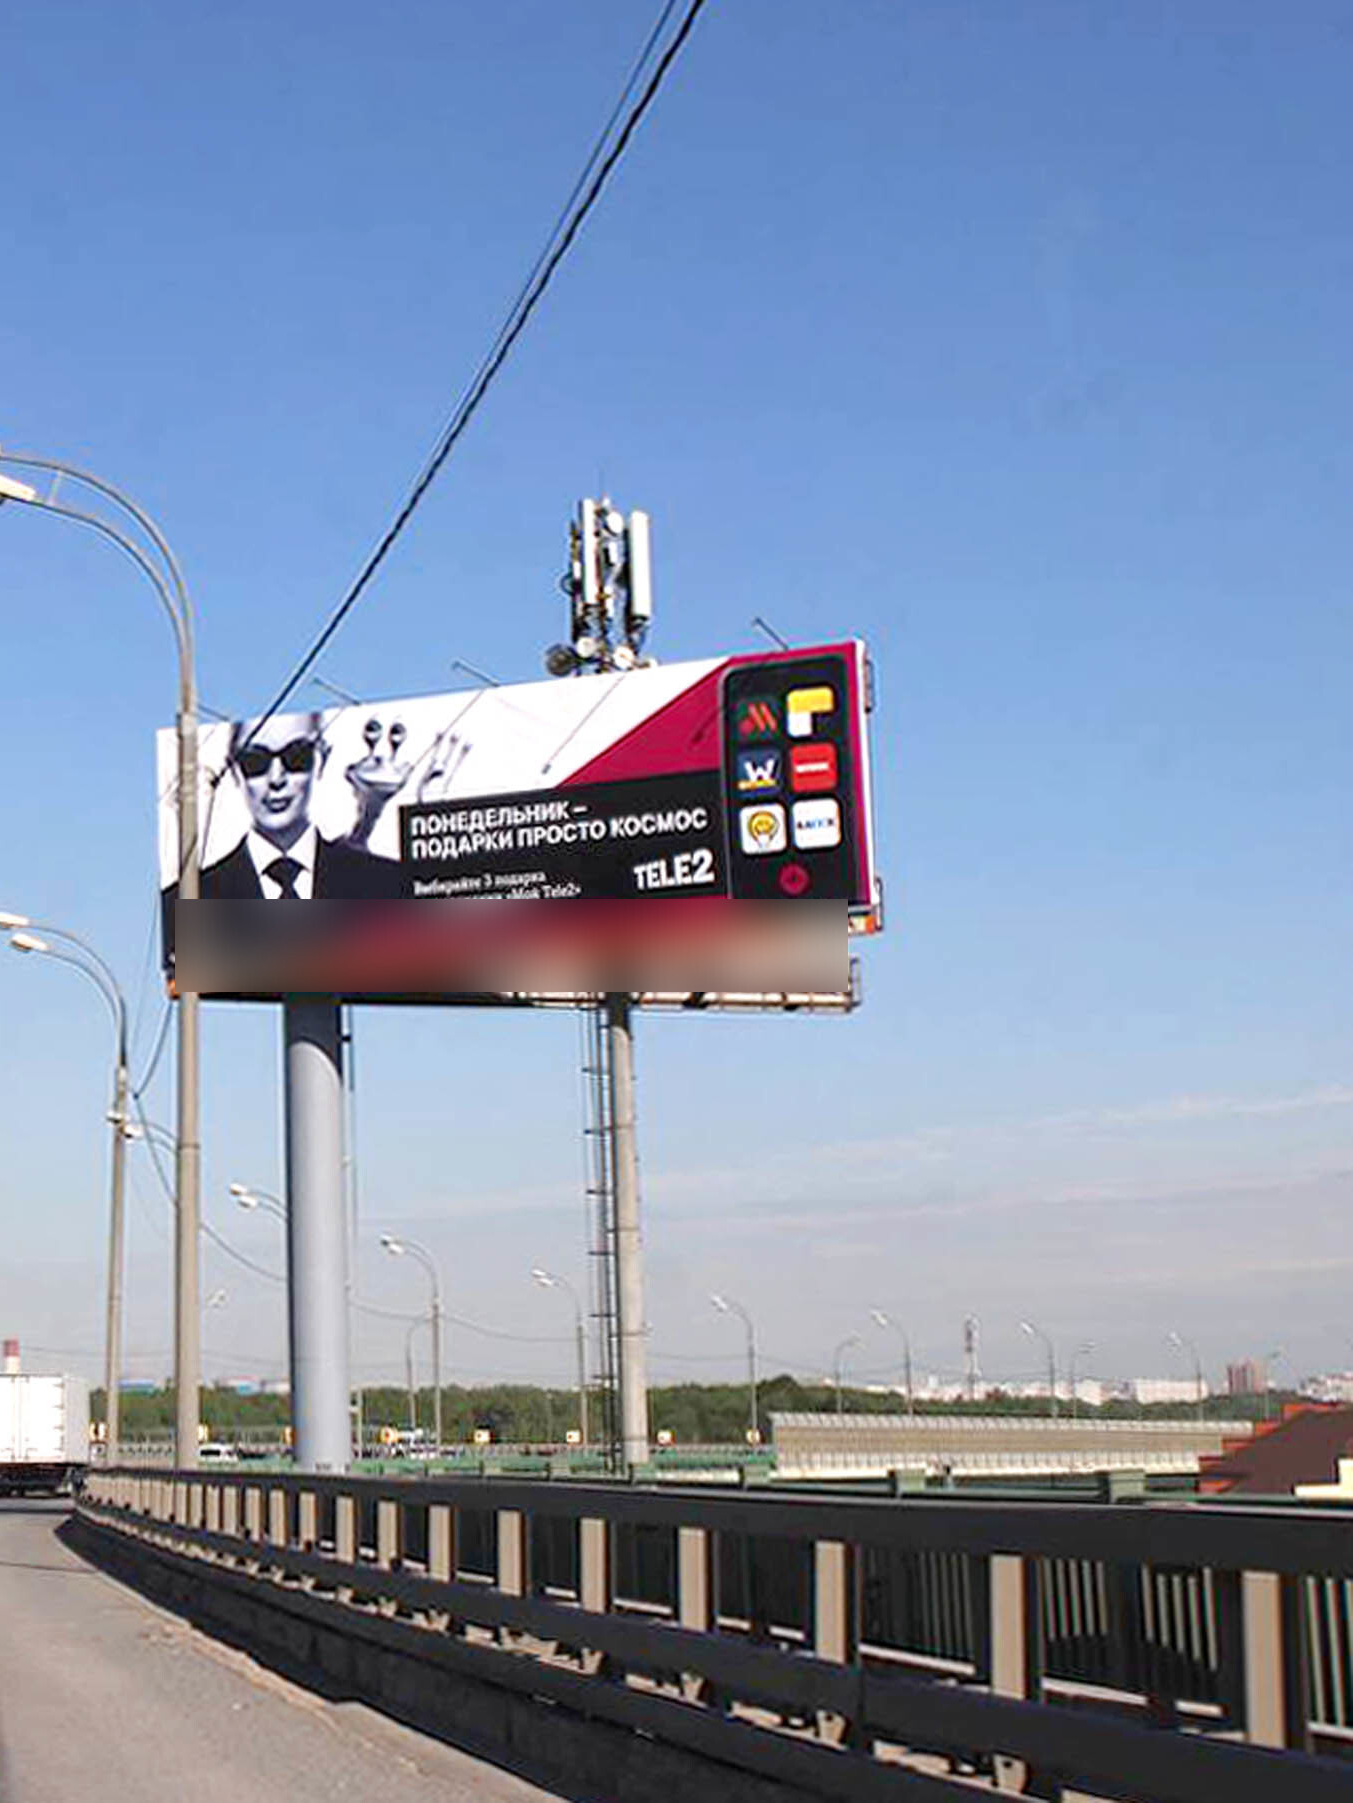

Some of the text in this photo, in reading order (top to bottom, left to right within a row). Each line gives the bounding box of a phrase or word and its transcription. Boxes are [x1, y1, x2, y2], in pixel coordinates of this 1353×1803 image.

[411, 801, 570, 837] ПОНЕДЕЛЬНИК
[412, 807, 708, 860] ПОДАРКИ ПРОСТО КОСМОС
[633, 848, 715, 890] TELE2
